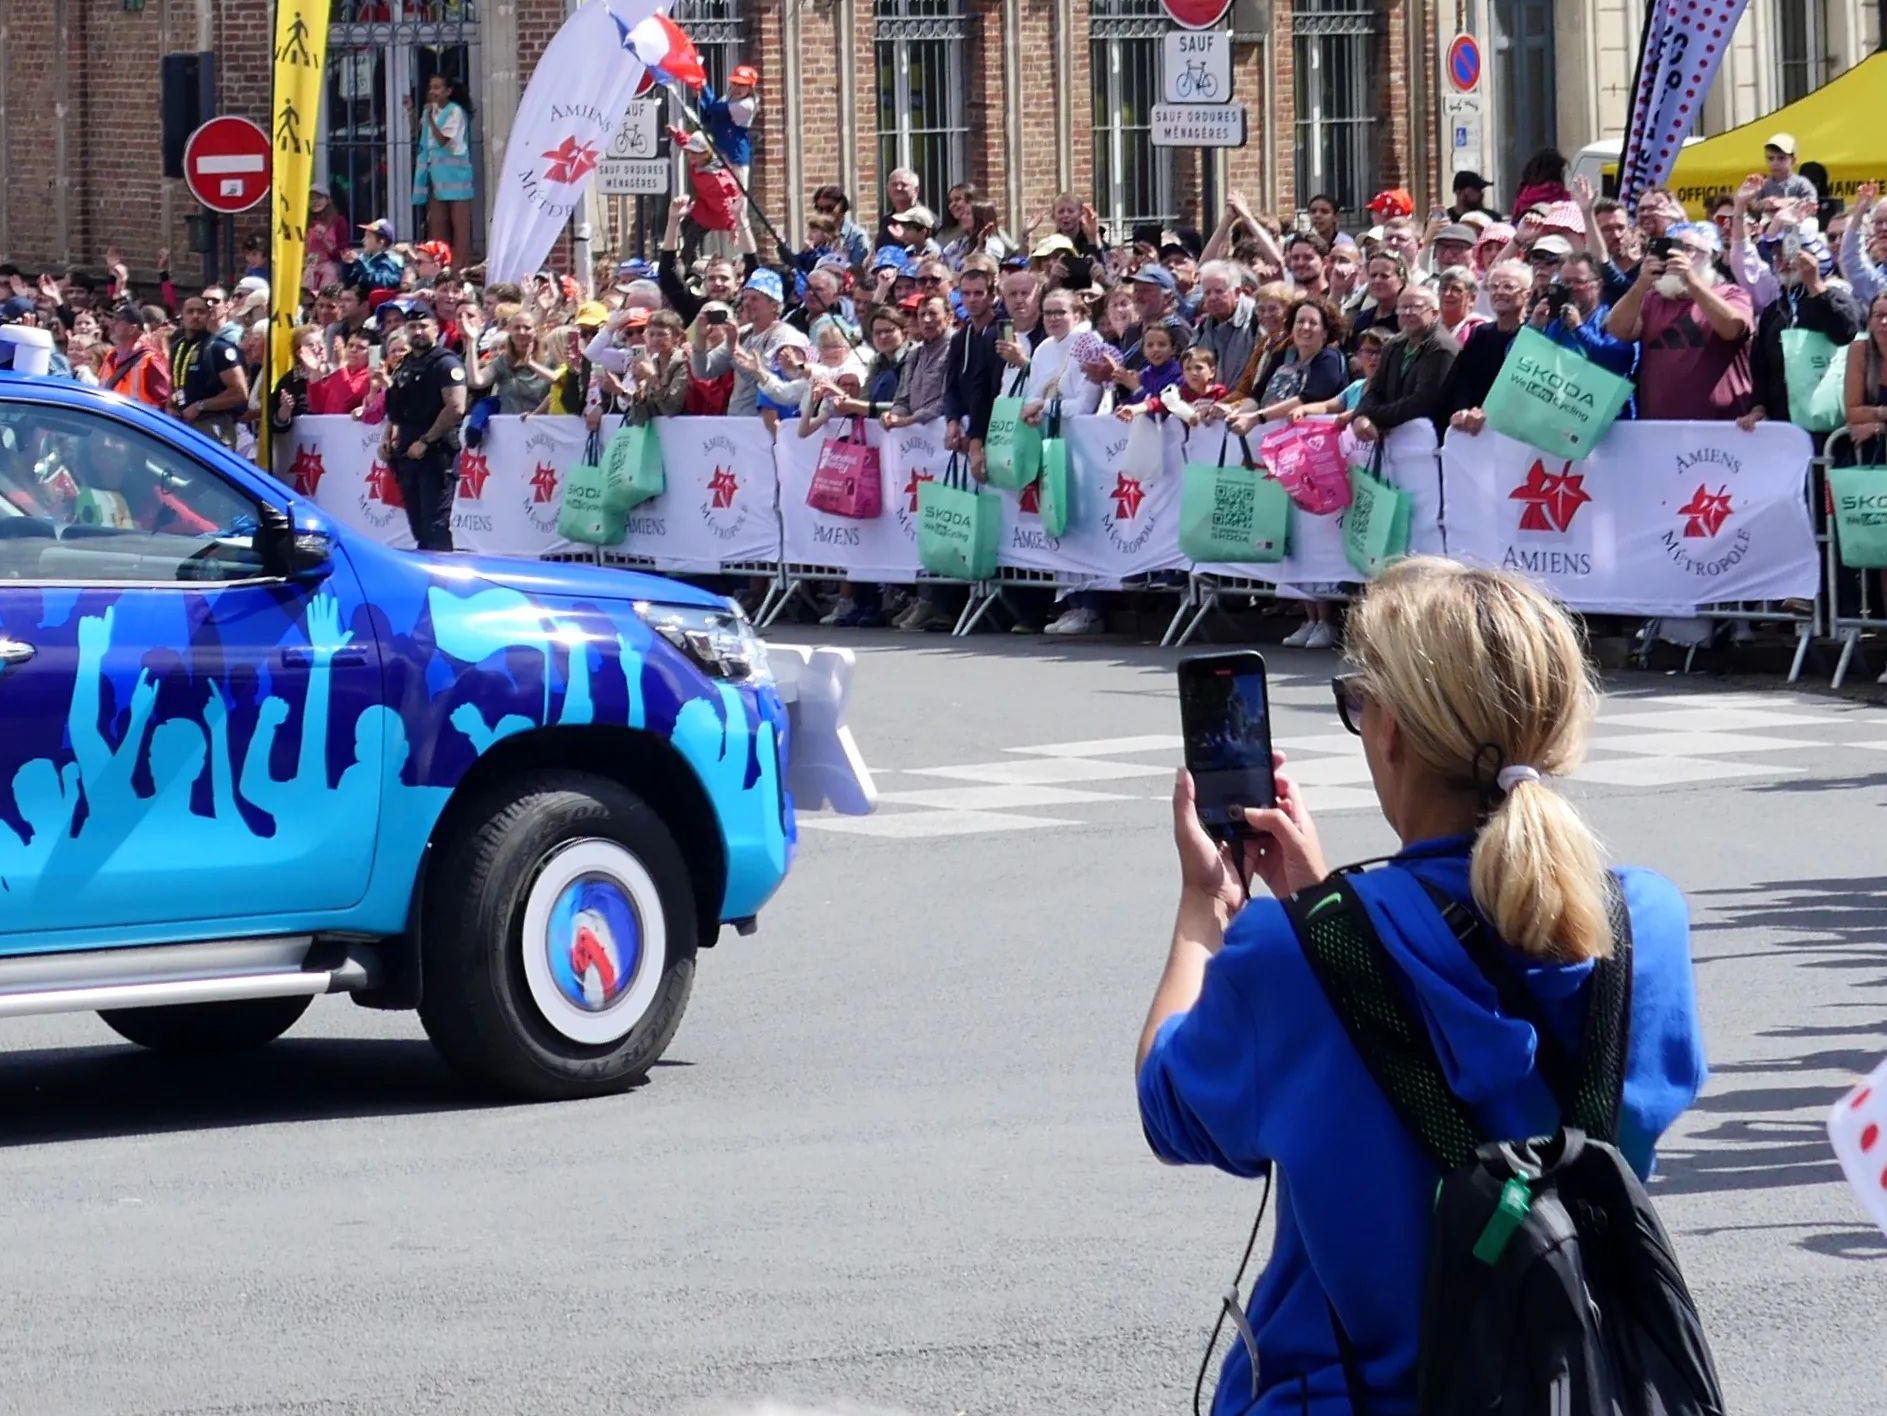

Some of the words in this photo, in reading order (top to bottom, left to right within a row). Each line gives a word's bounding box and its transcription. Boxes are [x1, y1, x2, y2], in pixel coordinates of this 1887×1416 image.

[1179, 35, 1214, 52] SAUF
[550, 104, 612, 133] AMIENS
[623, 103, 645, 117] AUF
[1155, 111, 1182, 122] SAUF
[1187, 111, 1238, 123] ORDURES
[598, 164, 621, 175] SAUF
[624, 165, 664, 176] ORDURES
[1675, 447, 1743, 475] AMIENS
[924, 505, 972, 529] SKODA
[1503, 544, 1592, 575] AMIENS
[1661, 527, 1752, 577] MÉTROPOLE
